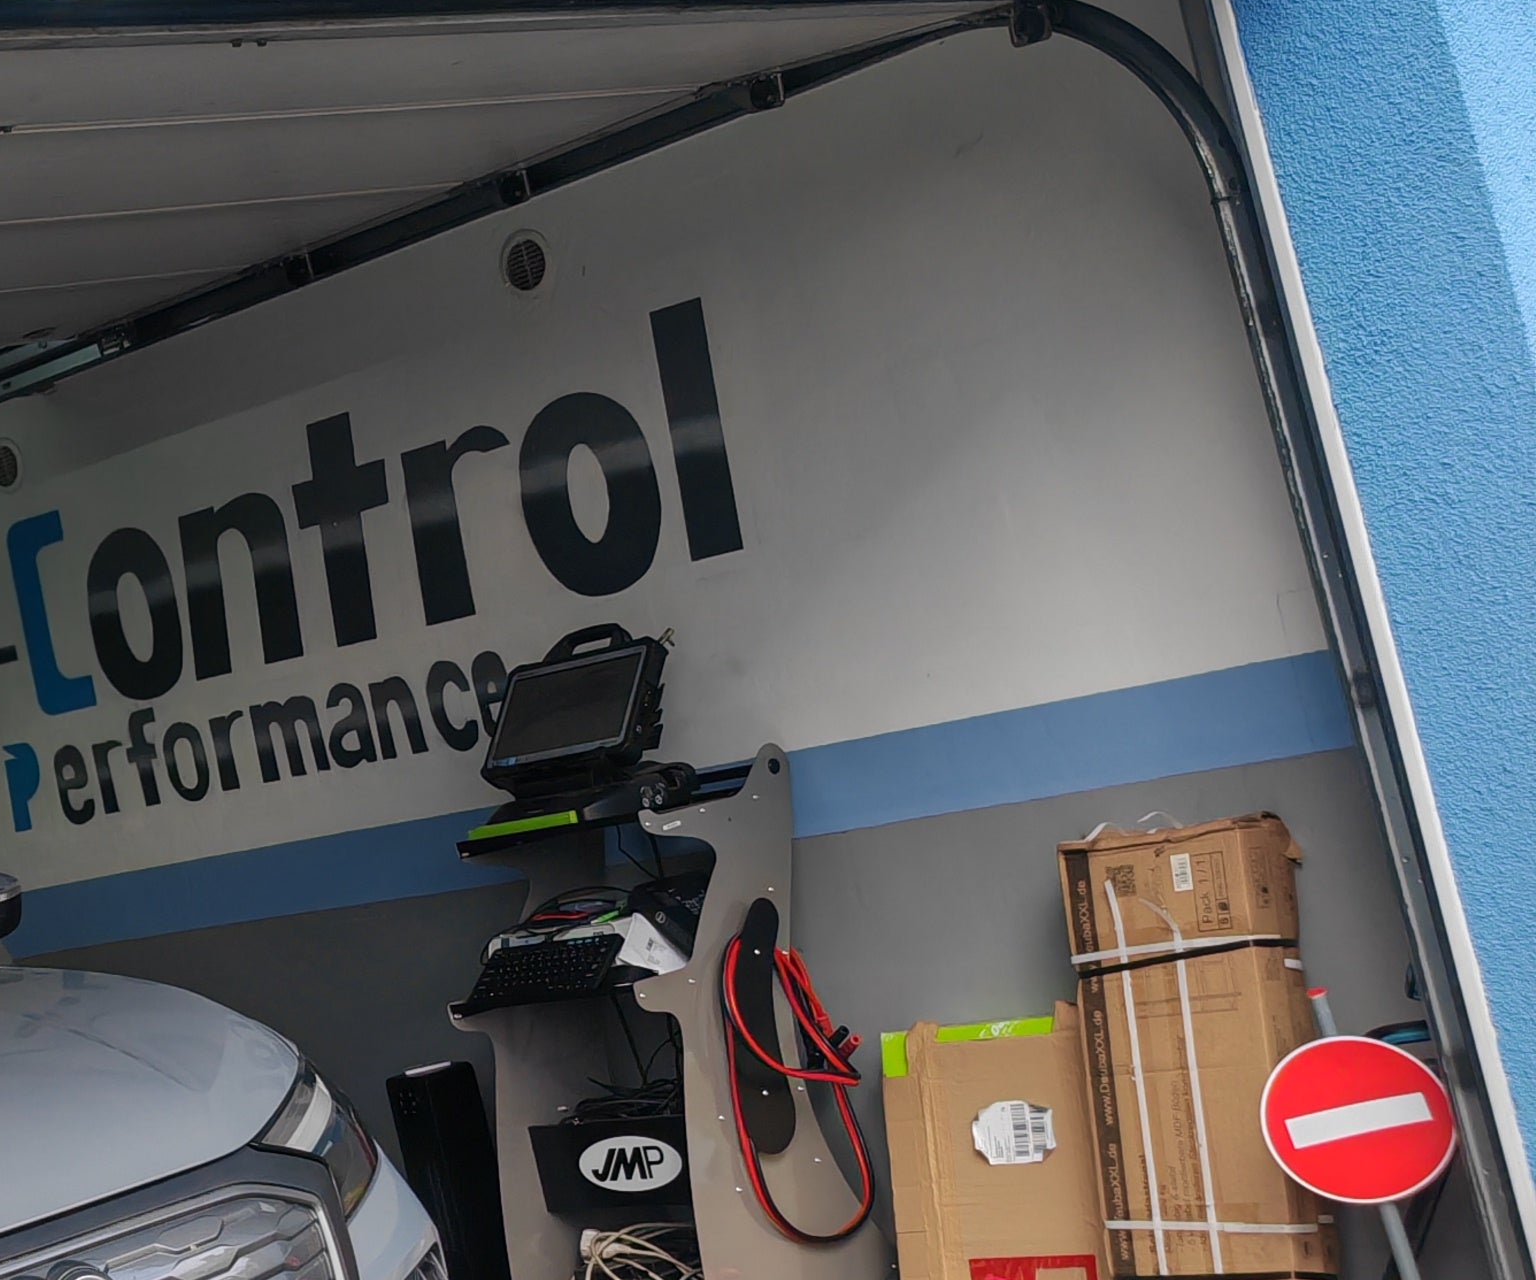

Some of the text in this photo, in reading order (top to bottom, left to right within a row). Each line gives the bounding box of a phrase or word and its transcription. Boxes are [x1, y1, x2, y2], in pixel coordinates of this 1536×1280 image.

[4, 650, 508, 832] Performance
[1199, 892, 1214, 924] Pack
[592, 1145, 664, 1182] JMP
